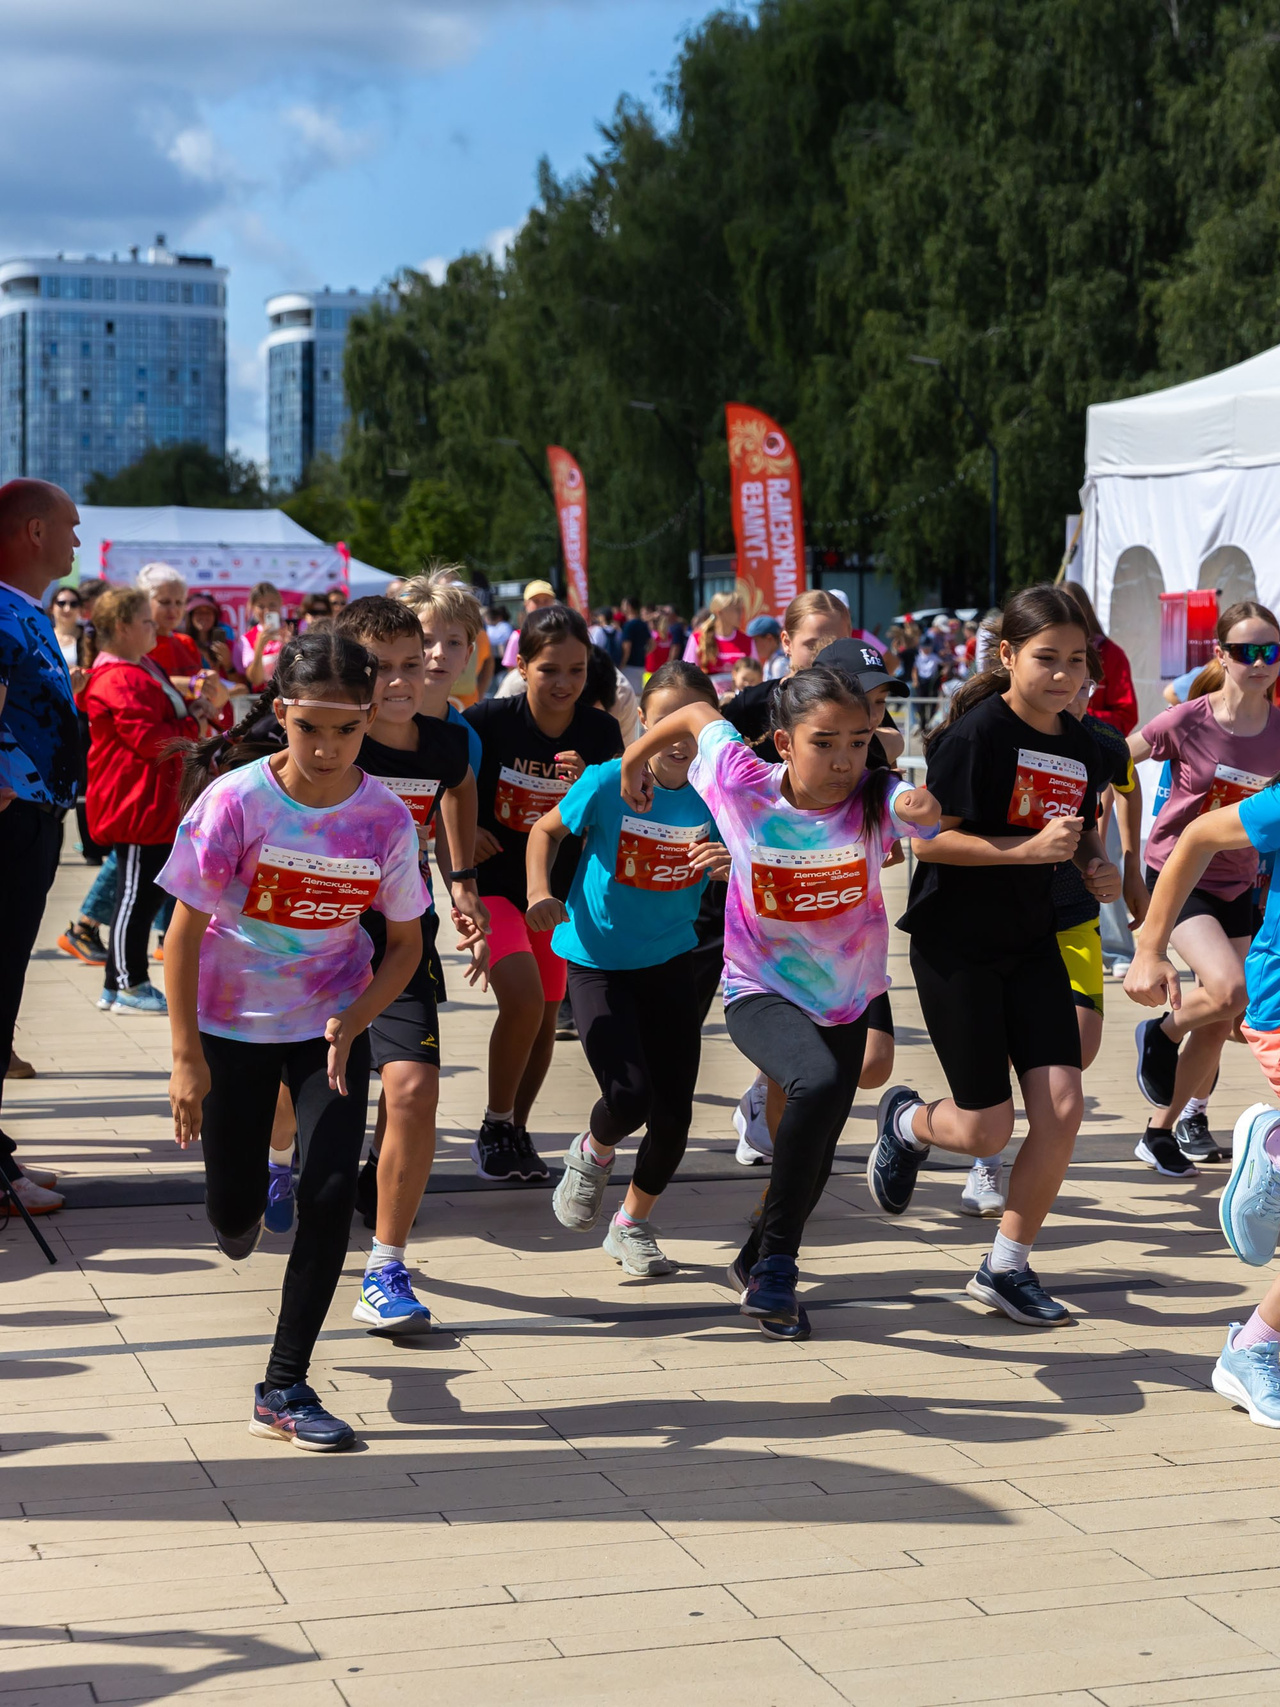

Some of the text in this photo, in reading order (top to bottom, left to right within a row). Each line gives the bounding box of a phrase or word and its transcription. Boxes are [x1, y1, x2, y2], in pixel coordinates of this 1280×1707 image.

[860, 648, 870, 658] I
[864, 656, 883, 666] ME
[793, 869, 841, 879] Детский
[831, 870, 861, 881] забег
[301, 876, 352, 889] Детский
[338, 887, 370, 896] забег
[795, 886, 863, 912] 256
[290, 900, 364, 920] 255
